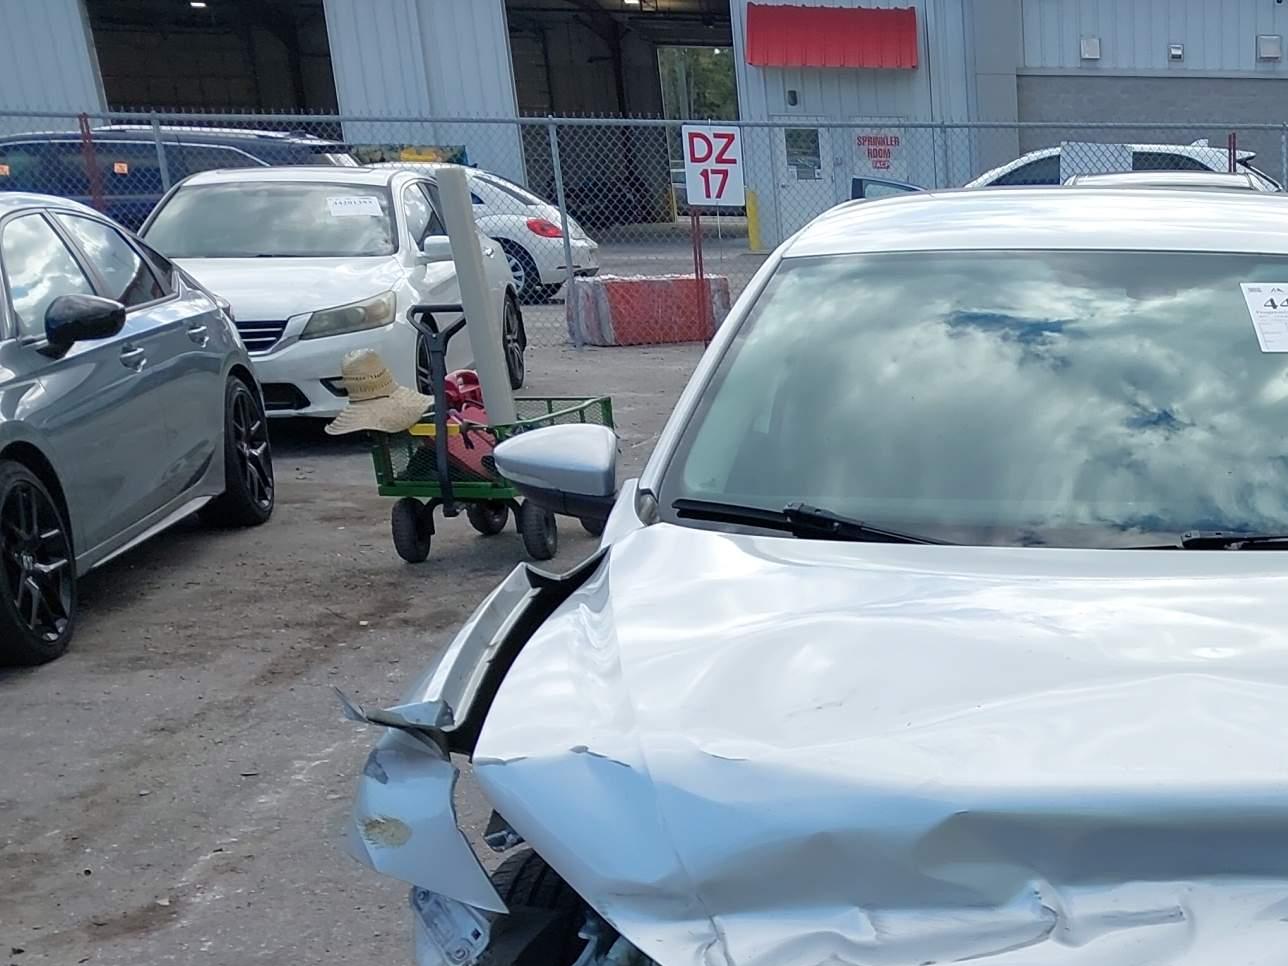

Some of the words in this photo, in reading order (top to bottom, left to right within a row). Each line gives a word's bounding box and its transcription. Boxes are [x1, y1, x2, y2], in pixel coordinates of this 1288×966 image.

[688, 132, 737, 164] DZ
[856, 135, 900, 146] SPRINKLER
[867, 148, 891, 159] ROOM
[700, 169, 729, 199] 17
